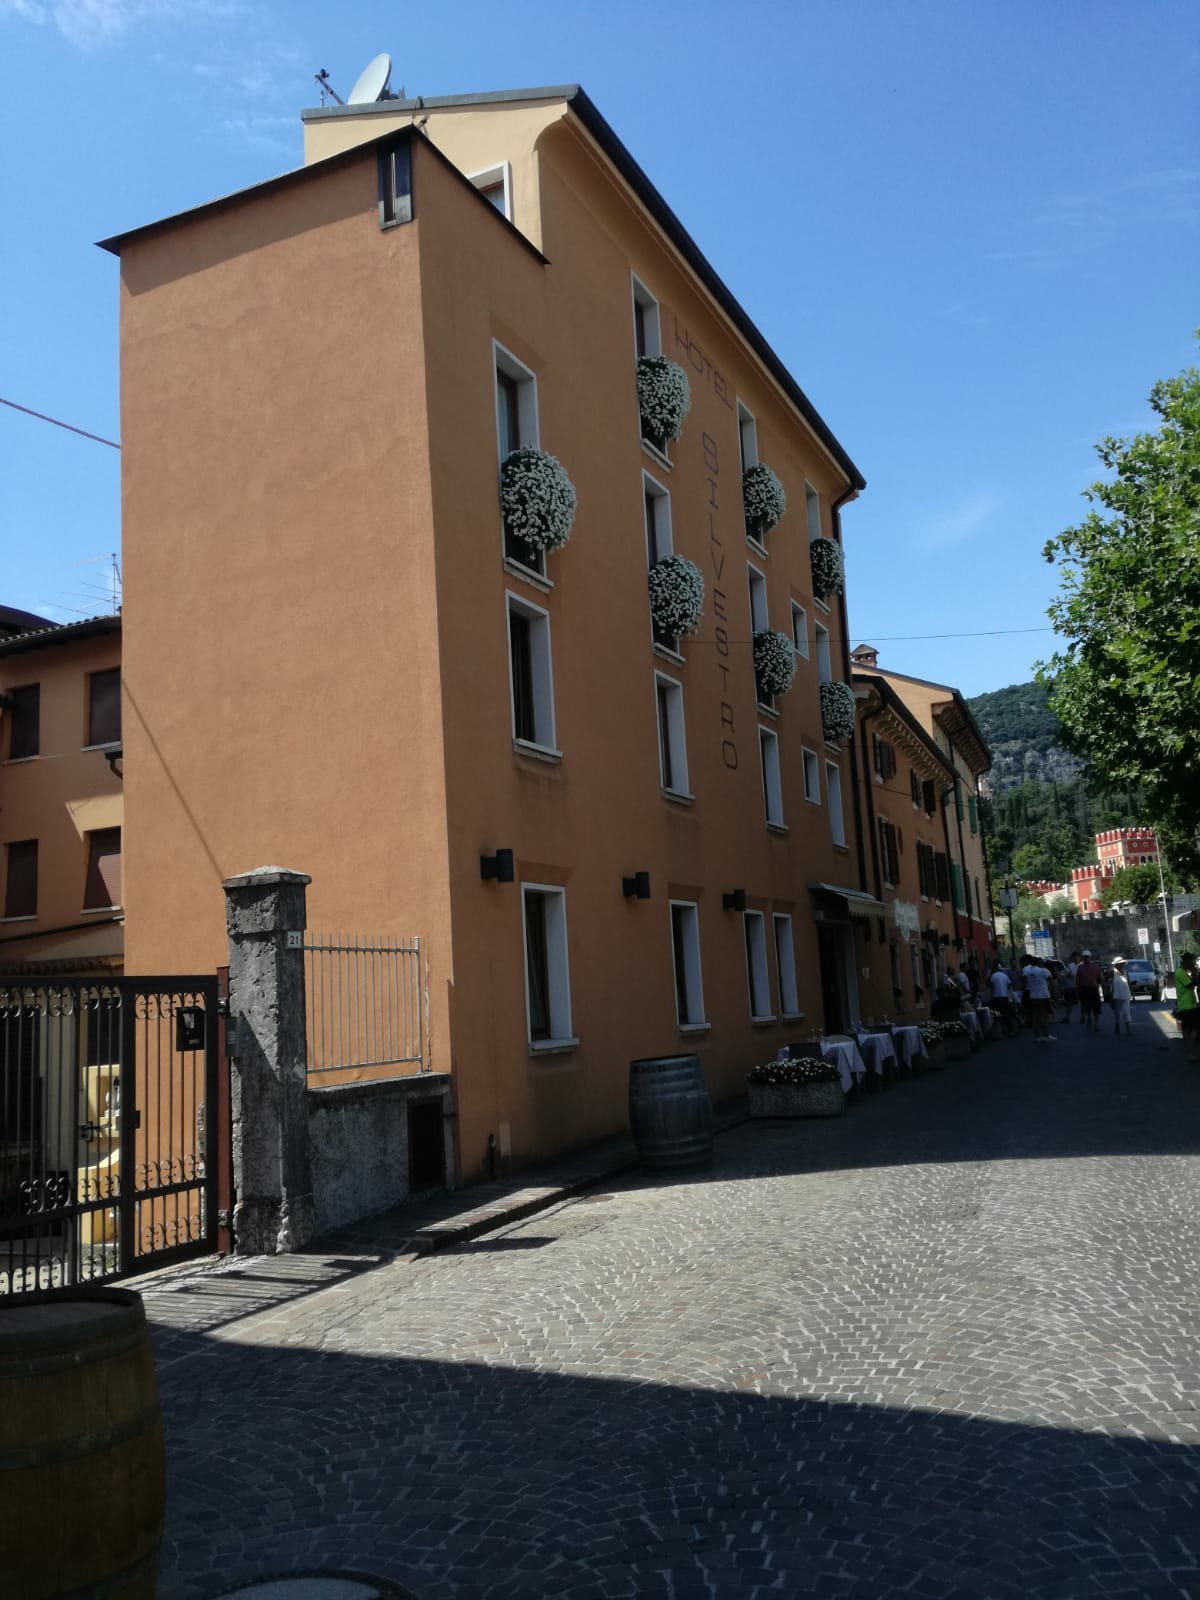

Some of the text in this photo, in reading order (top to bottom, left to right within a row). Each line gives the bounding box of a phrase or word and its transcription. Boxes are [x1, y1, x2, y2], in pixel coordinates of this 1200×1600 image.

[673, 315, 734, 411] HOTEL
[702, 431, 739, 771] SILVESTRO
[289, 935, 299, 945] 21
